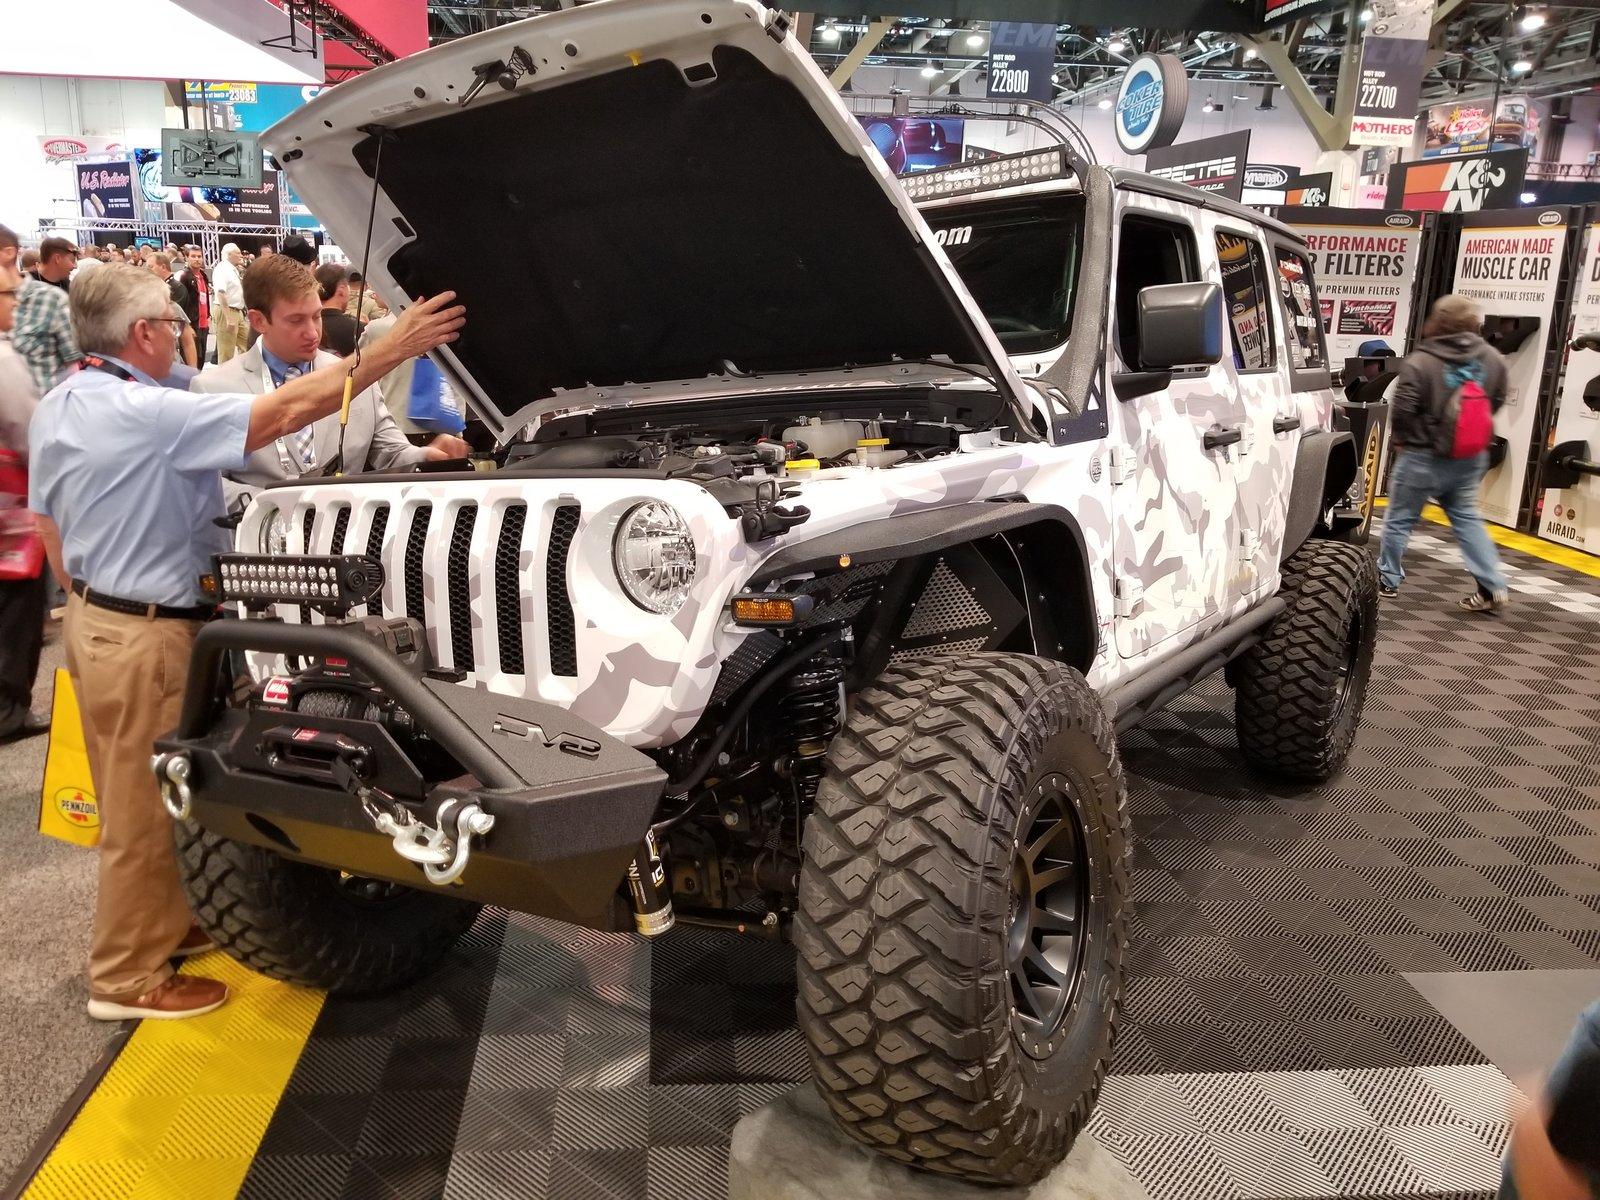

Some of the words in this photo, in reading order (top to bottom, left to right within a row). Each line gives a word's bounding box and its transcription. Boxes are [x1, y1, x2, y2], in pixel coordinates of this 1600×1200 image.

[991, 69, 1029, 93] 22800
[1360, 85, 1397, 109] 22700
[1353, 122, 1413, 135] MOTHERS
[100, 170, 129, 190] Radiator
[1244, 170, 1284, 187] ynamat
[1388, 217, 1410, 225] AIRAID
[933, 226, 972, 246] om
[1465, 239, 1520, 254] AMERICAN
[1521, 238, 1555, 254] MADE
[1325, 253, 1405, 277] FILTERS
[1460, 257, 1516, 280] MUSCLE
[1520, 257, 1551, 280] CAR
[1326, 285, 1364, 295] PREMIUM
[1368, 286, 1400, 296] FILTERS
[1458, 289, 1496, 300] PERFORMANCE
[1497, 291, 1517, 301] INTAKE
[1518, 291, 1545, 302] SYSTEMS
[62, 800, 97, 814] PENNZOIL
